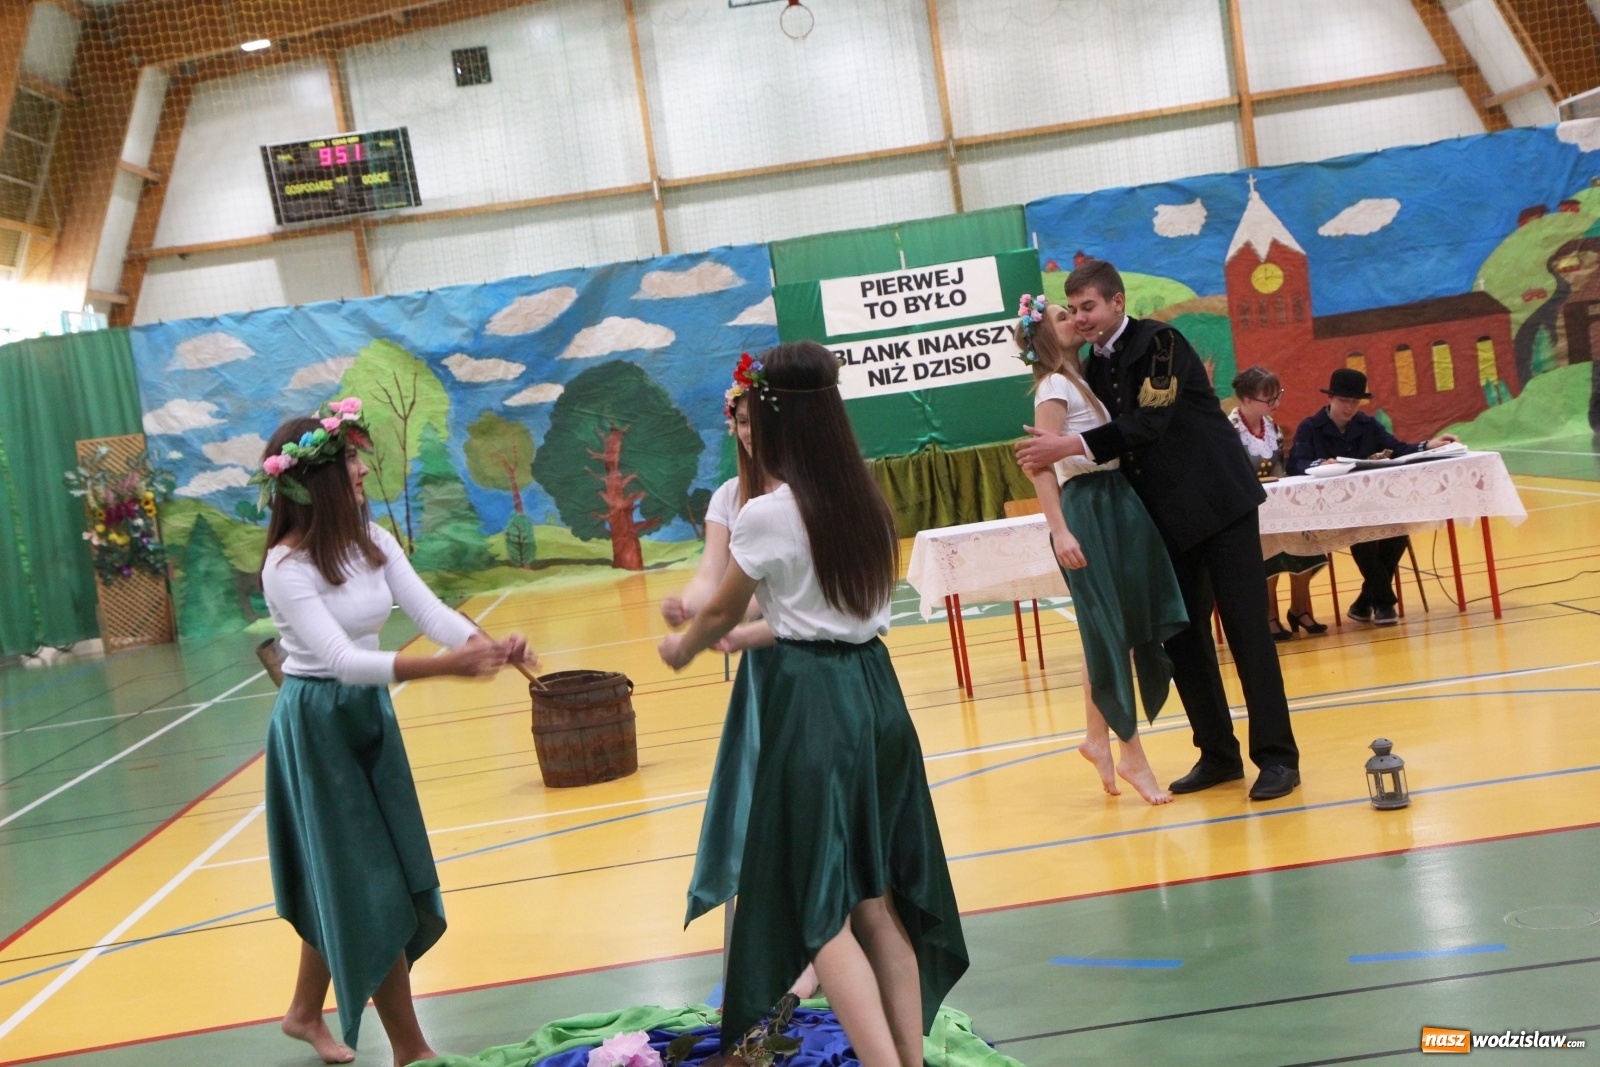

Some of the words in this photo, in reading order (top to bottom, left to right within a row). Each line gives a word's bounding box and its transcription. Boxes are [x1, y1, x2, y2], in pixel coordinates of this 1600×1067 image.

[860, 267, 964, 298] PIERWEJ
[864, 301, 897, 320] TO
[904, 289, 967, 314] BYŁO
[831, 340, 912, 366] BLANK
[867, 362, 908, 387] NIŻ
[913, 352, 991, 381] DZISIO
